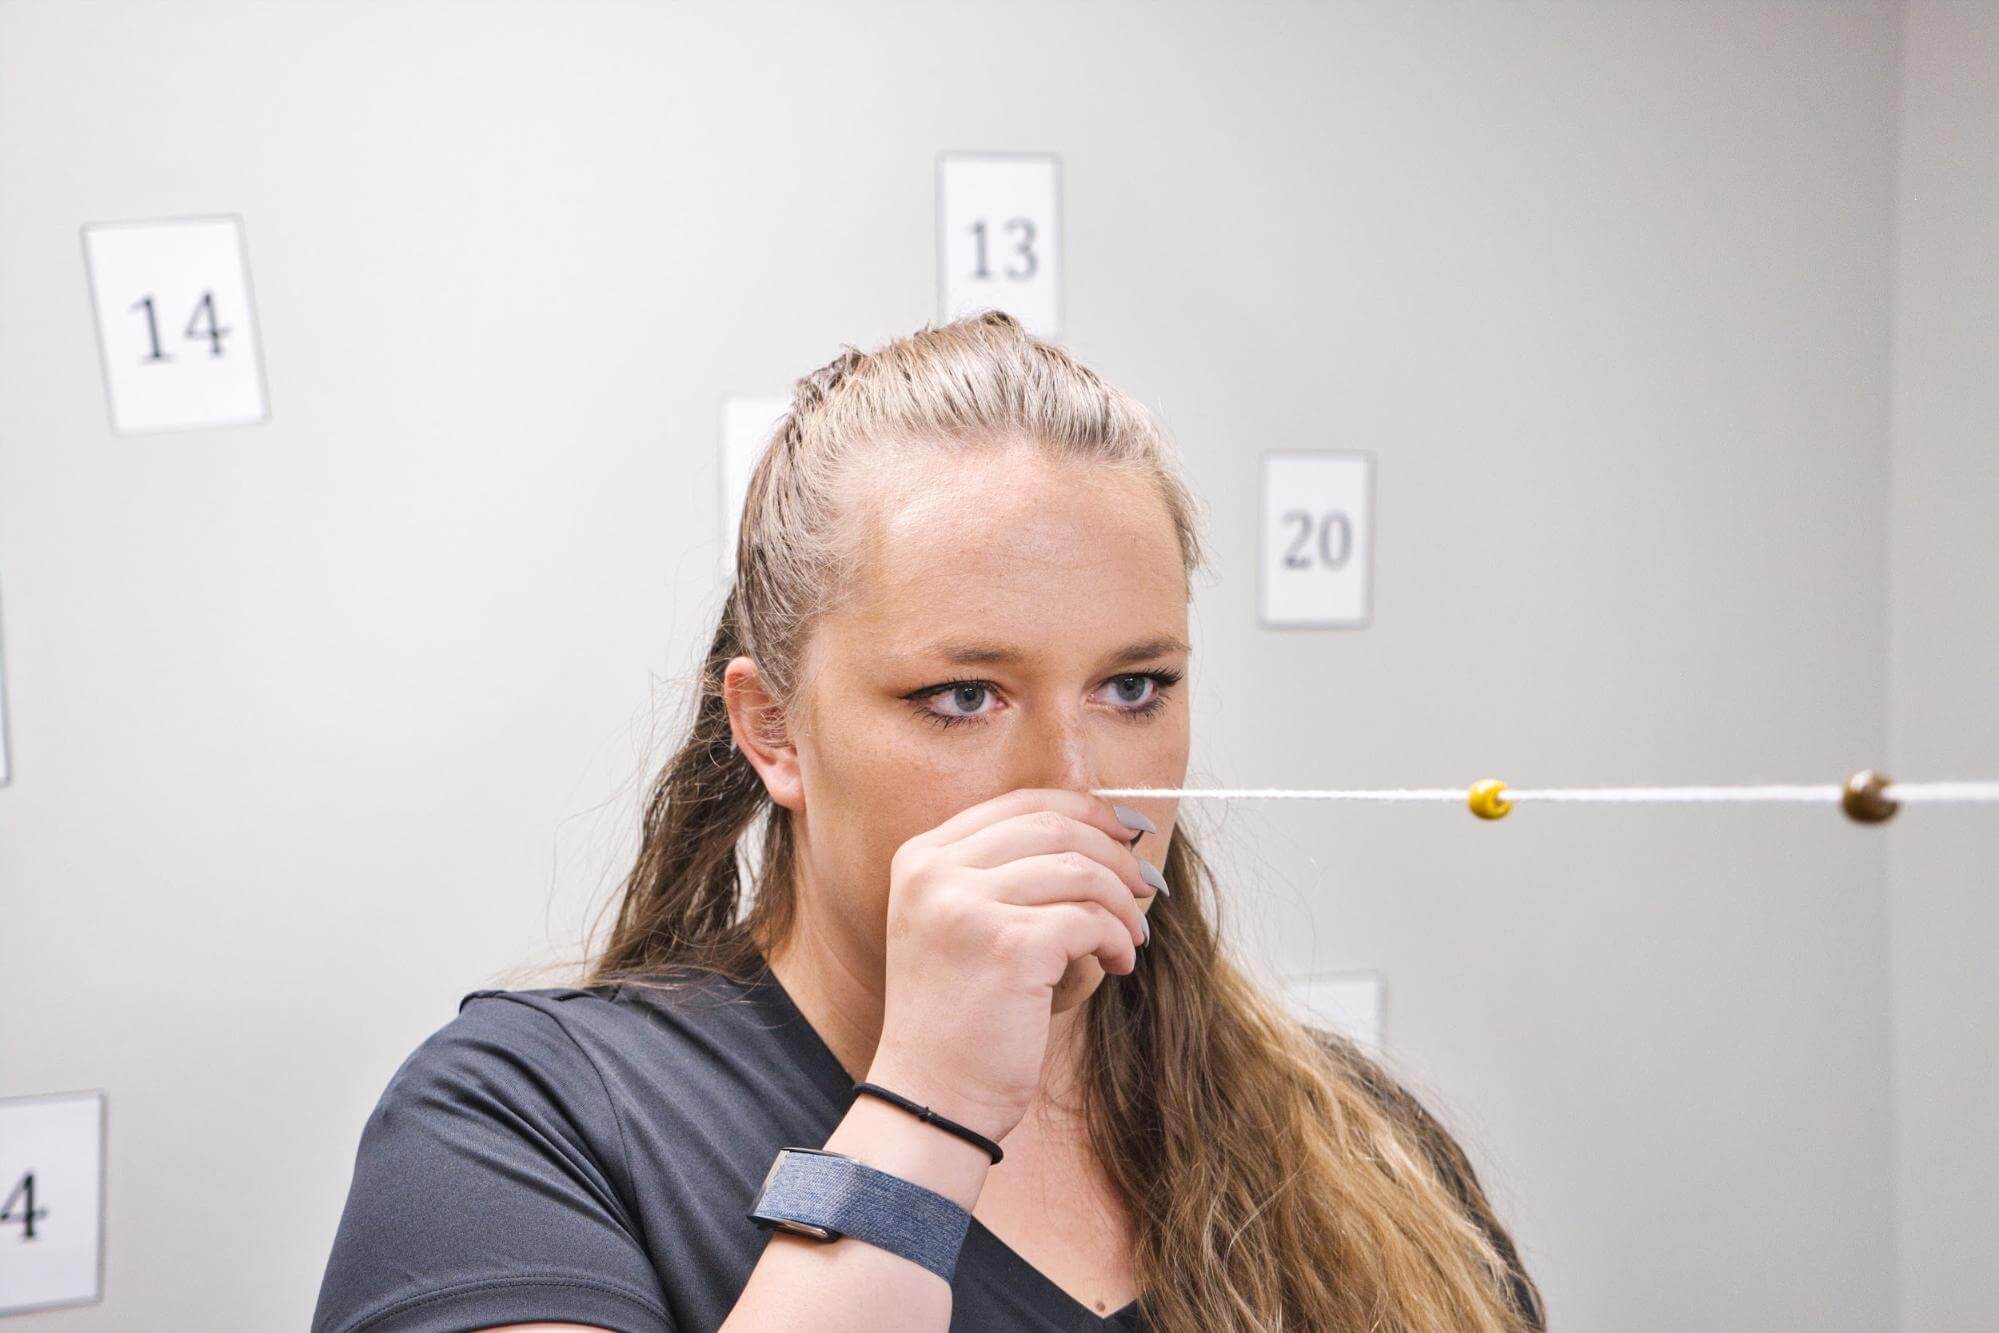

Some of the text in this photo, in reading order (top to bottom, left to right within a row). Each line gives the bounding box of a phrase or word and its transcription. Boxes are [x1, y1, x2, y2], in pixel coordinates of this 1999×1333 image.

[967, 219, 1040, 281] 13
[129, 288, 231, 364] 14
[1281, 510, 1353, 571] 20
